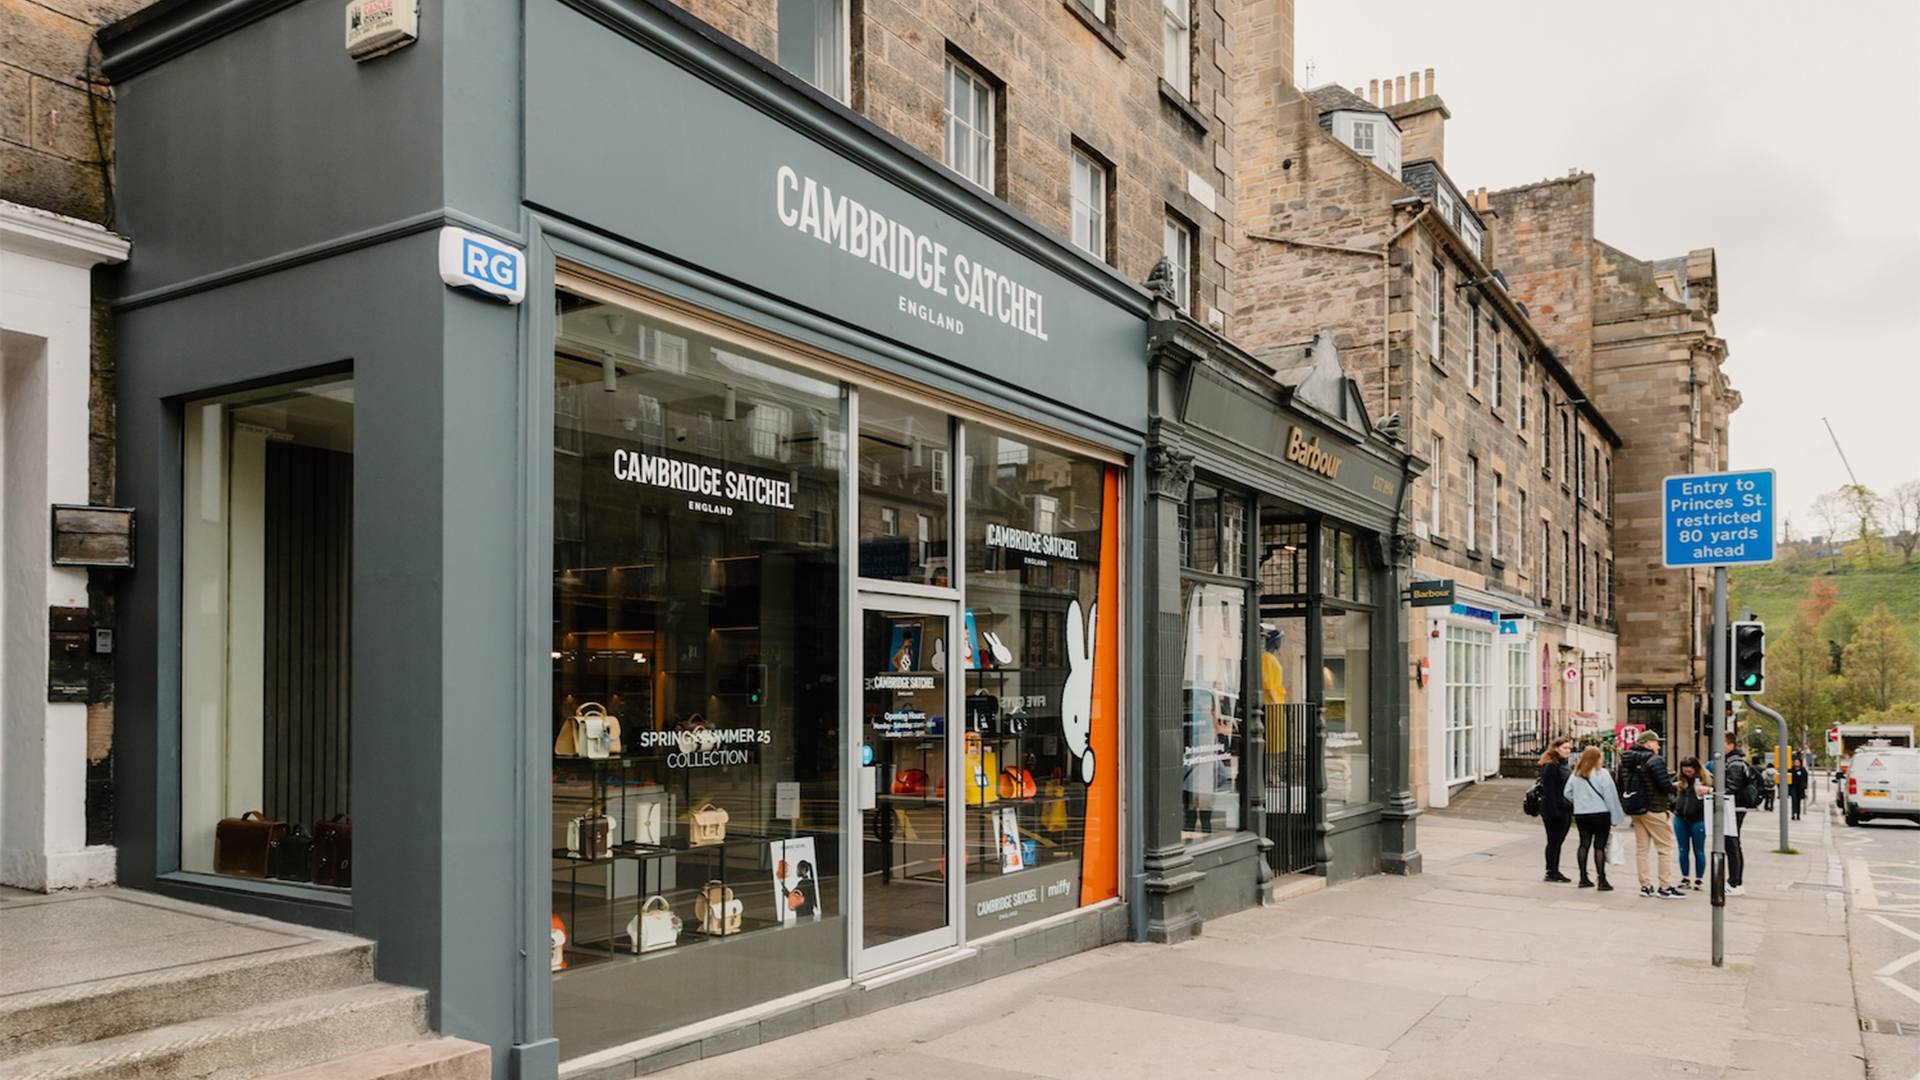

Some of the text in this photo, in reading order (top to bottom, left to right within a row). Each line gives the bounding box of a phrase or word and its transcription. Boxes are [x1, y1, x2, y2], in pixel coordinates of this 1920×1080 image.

[776, 165, 1048, 341] CAMBRIDGE SATCHEL
[466, 244, 514, 286] RG
[898, 295, 964, 335] ENGLAND
[1287, 426, 1343, 479] Barbour
[614, 449, 794, 509] CAMBRIDGE SATCHEL
[1682, 479, 1755, 495] Entry to
[688, 500, 734, 516] ENGLAND
[1671, 494, 1767, 512] Princes St.
[1676, 510, 1762, 527] restricted
[987, 524, 1079, 560] CAMBRIDGE SATCHEL
[1679, 527, 1758, 543] 80 yards
[1693, 544, 1745, 559] ahead
[1024, 557, 1047, 567] ENGLAND
[1413, 589, 1451, 599] Barbour
[874, 676, 909, 689] CAMBRIDGE
[757, 730, 771, 744] 25
[667, 750, 748, 768] COLLECTION
[1048, 879, 1071, 897] miffy
[977, 888, 1038, 916] CAMBRIDGE SATCHEL
